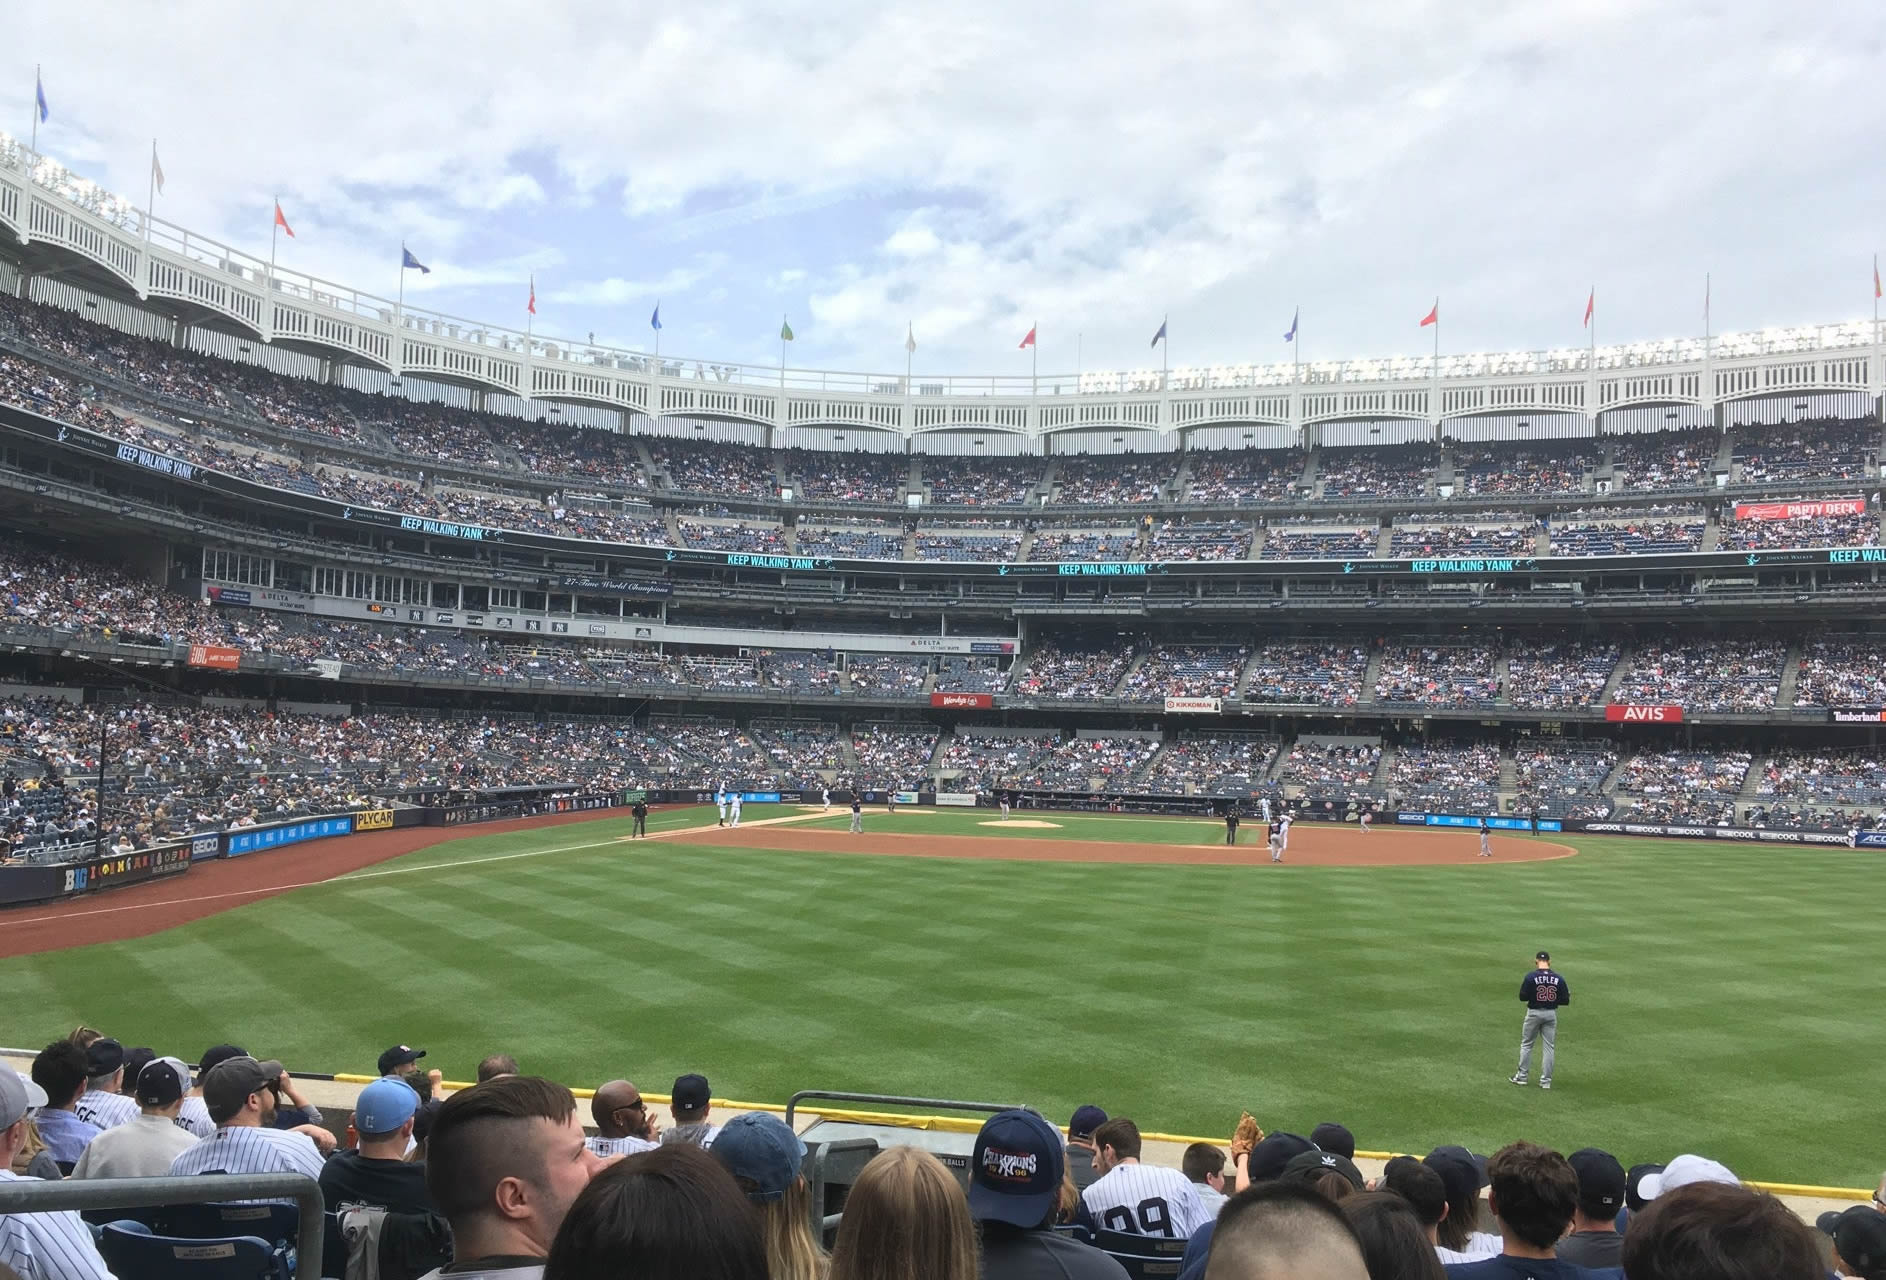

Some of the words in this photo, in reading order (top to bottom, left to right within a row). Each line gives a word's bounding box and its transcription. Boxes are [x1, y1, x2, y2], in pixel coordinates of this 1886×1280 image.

[117, 444, 138, 463] KEEP
[138, 450, 173, 474] WALKING
[173, 461, 193, 479] YANK
[1787, 504, 1823, 517] PARTY
[1826, 503, 1857, 515] DECK
[401, 516, 422, 530] KEEP
[423, 519, 459, 537] WALKING
[459, 525, 483, 540] YANK
[727, 554, 750, 566] KEEP
[750, 556, 789, 568] WALKING
[790, 558, 814, 569] YANK
[1829, 550, 1859, 562] KEEP
[1058, 564, 1080, 575] KEEP
[1081, 564, 1120, 575] WALKING
[1121, 564, 1146, 575] YANK
[1412, 561, 1437, 572] KEEP
[1438, 560, 1484, 572] WALKING
[1484, 560, 1512, 571] YANK
[564, 577, 599, 588] 27-Time
[601, 579, 627, 590] World
[627, 582, 669, 594] Champions
[268, 593, 289, 601] DELTA
[191, 646, 208, 665] JBL
[1176, 701, 1212, 709] KIKKOMAN
[1623, 706, 1665, 721] AVIS
[1833, 711, 1881, 722] Timberland
[358, 811, 393, 826] PLYCAR
[1733, 831, 1756, 839] COOL
[1777, 832, 1800, 841] COOL
[192, 838, 218, 855] GEICO
[1534, 975, 1559, 987] KEPLER
[1536, 985, 1558, 1002] 26
[947, 1158, 965, 1167] BALLS
[1103, 1197, 1174, 1239] 99
